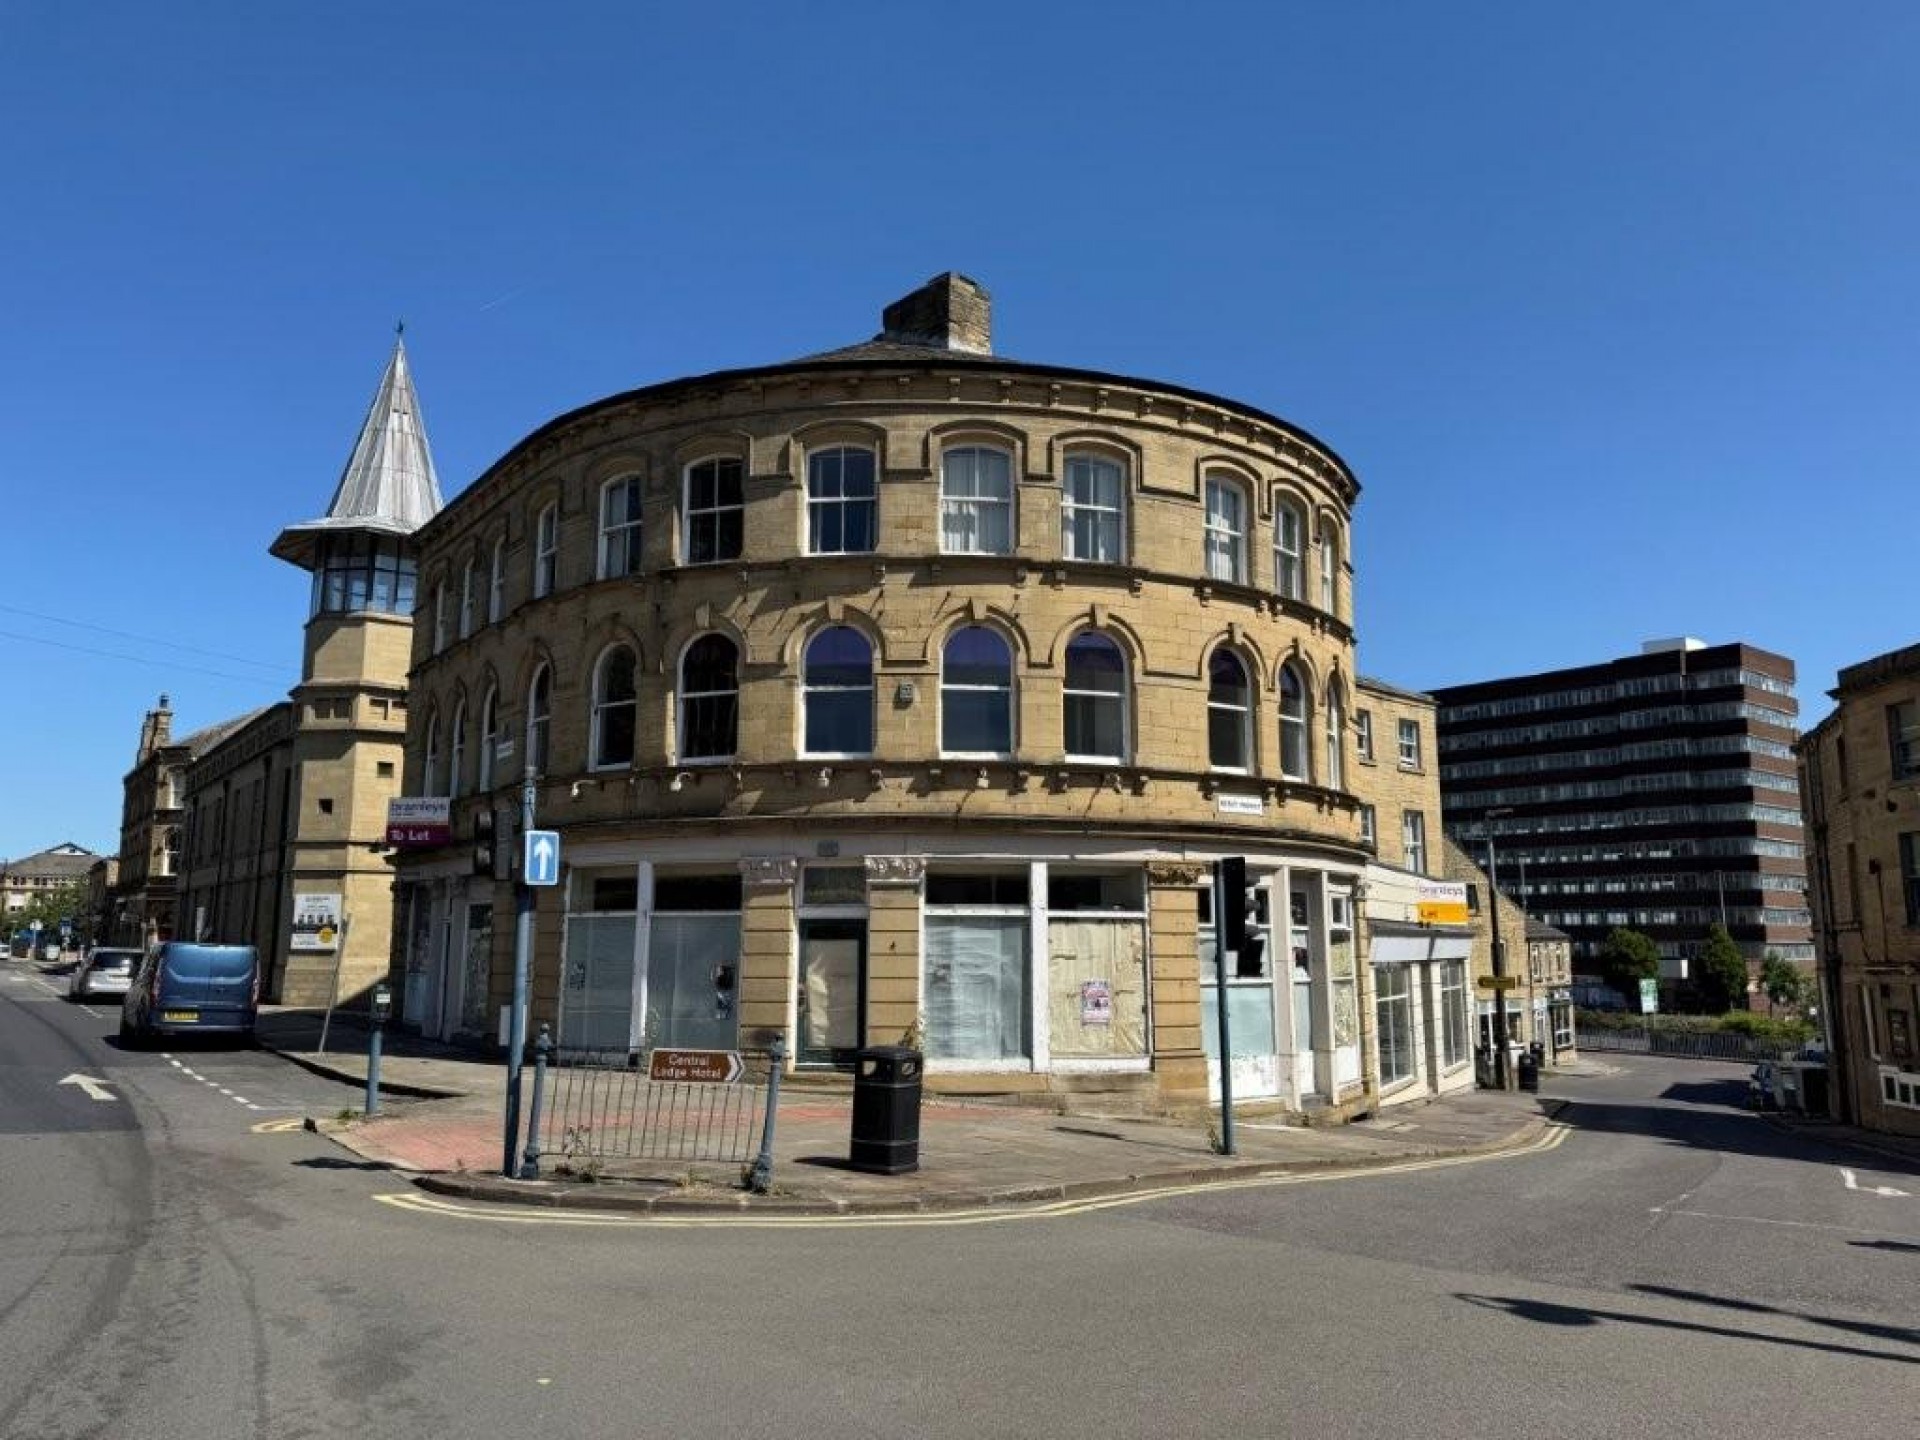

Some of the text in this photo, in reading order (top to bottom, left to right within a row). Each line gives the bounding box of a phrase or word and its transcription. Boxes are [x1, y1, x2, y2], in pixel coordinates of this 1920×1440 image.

[390, 830, 430, 841] To Let
[669, 1054, 709, 1066] Central
